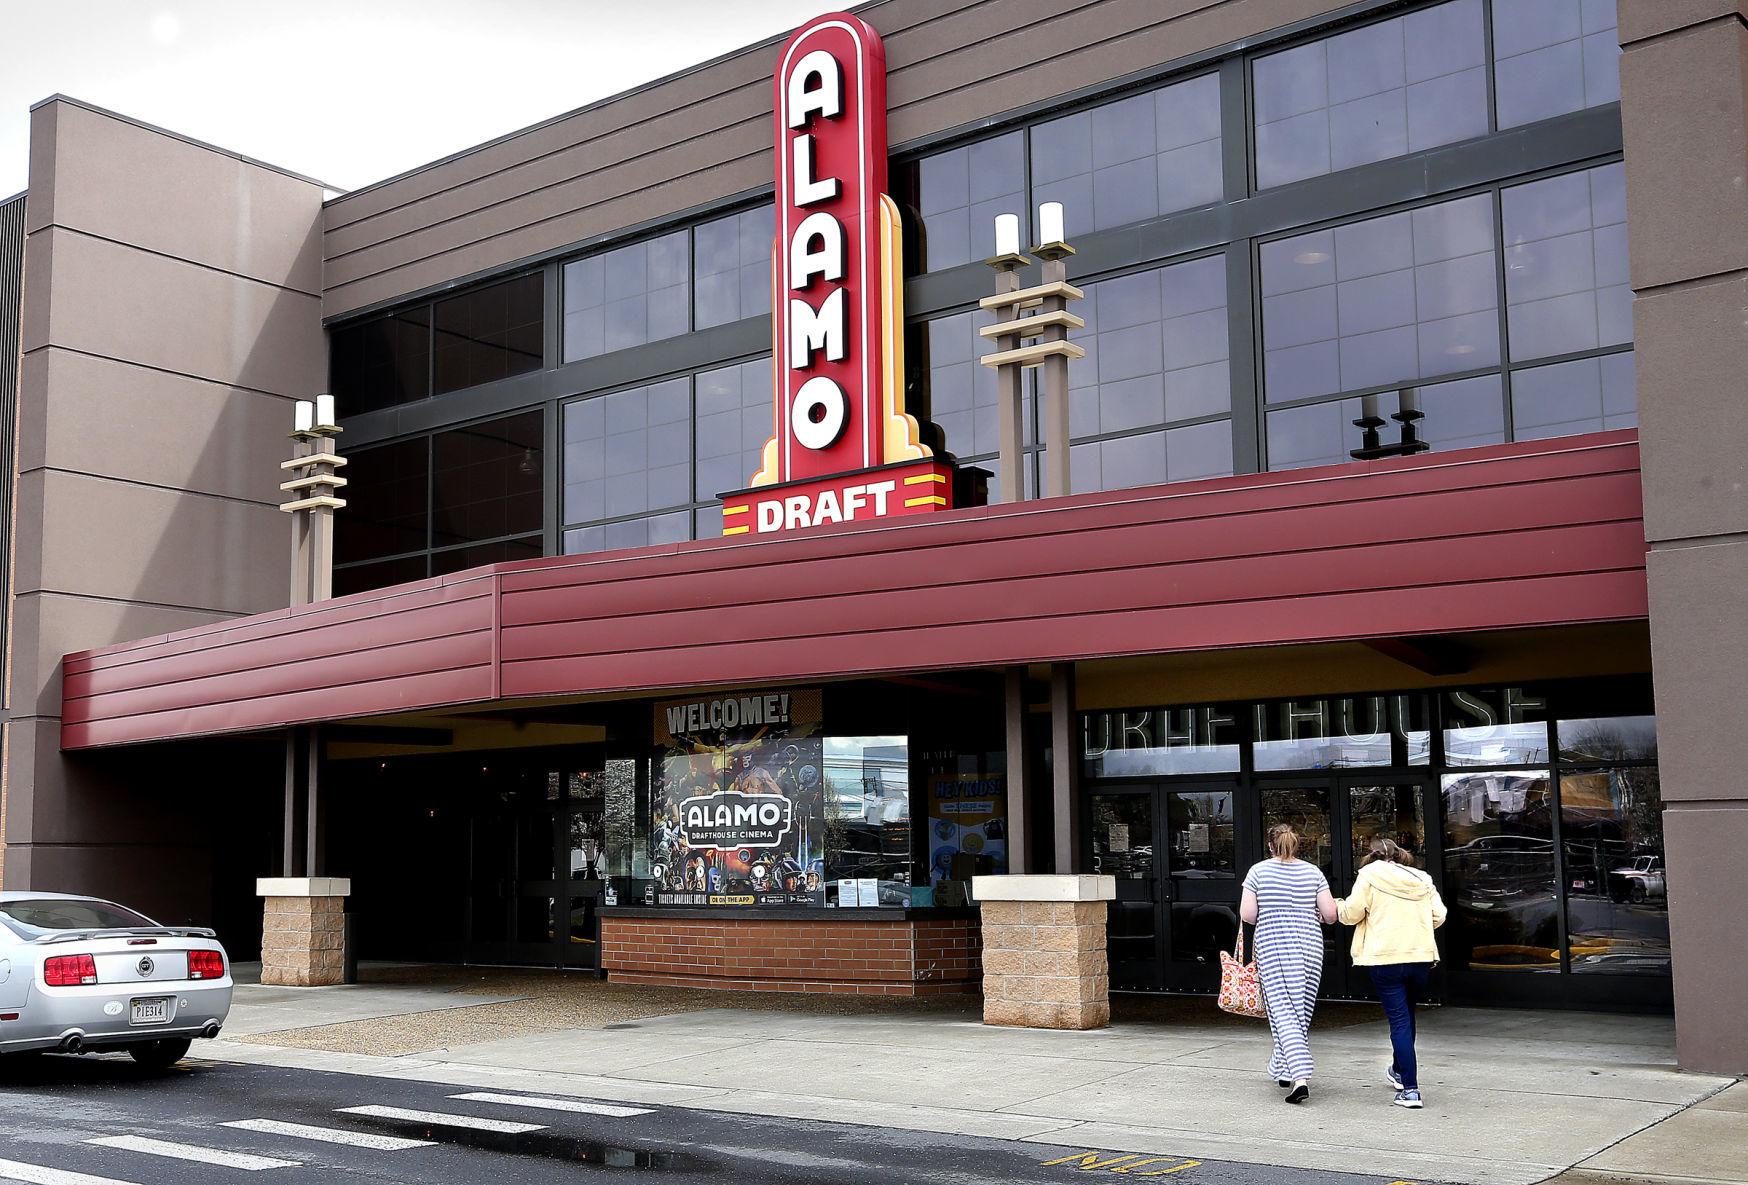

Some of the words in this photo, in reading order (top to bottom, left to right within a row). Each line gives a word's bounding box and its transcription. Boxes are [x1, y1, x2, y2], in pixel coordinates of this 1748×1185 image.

[788, 49, 850, 451] ALAMO
[757, 480, 896, 534] DRAFT
[666, 693, 789, 735] WELCOME!
[687, 802, 781, 828] ALAMO
[691, 831, 737, 840] DRAFTHOUSE
[739, 830, 774, 839] CINEMA
[136, 1005, 163, 1018] PIE314
